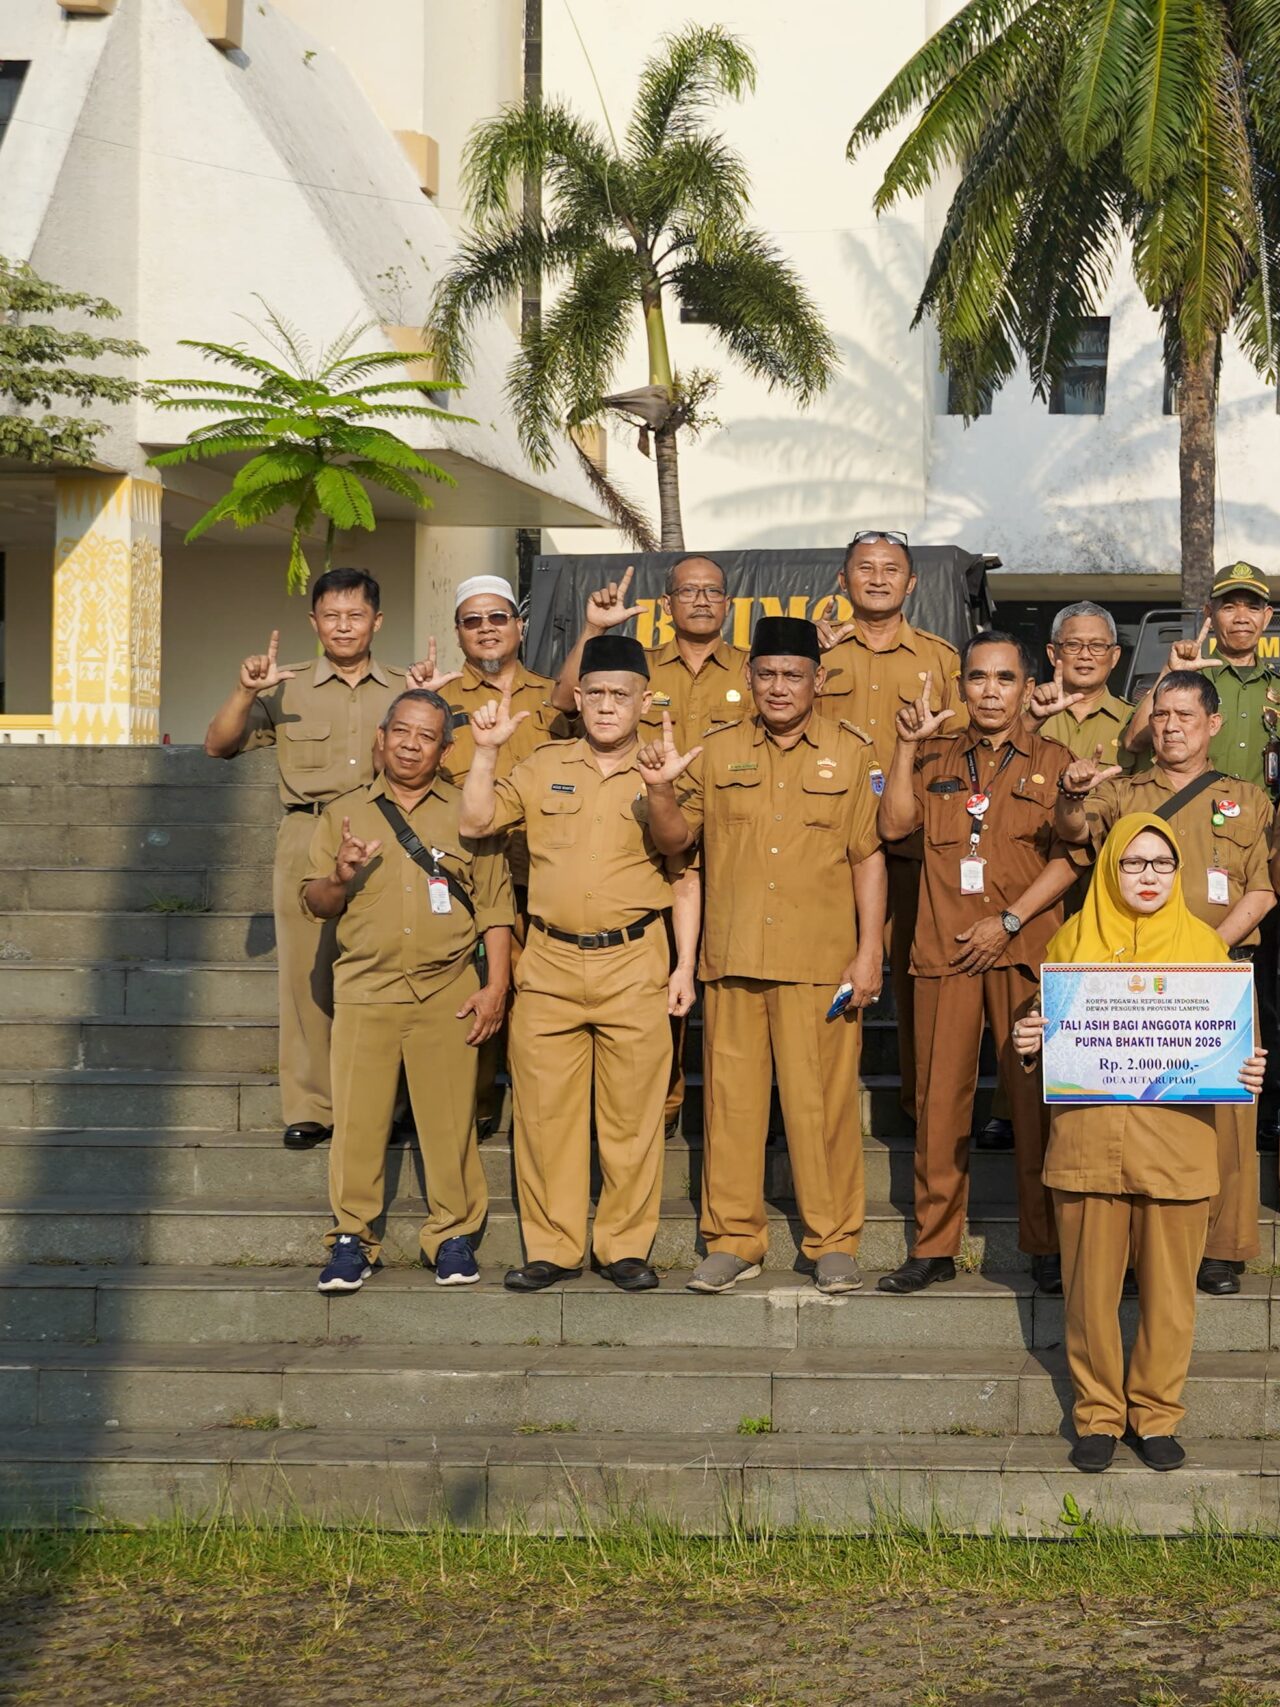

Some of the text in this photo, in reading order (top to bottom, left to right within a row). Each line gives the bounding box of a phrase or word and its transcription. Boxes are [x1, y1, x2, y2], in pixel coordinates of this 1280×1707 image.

[1060, 1020, 1236, 1030] TALI ASIH BAGI ANGGOTA KORPRI
[1075, 1037, 1221, 1047] PURNA BHAKTI TAHUN 2026
[1099, 1058, 1199, 1073] Rp. 2.000.000,-
[1103, 1077, 1126, 1085] (DUA
[1156, 1076, 1196, 1085] RUPIAH)
